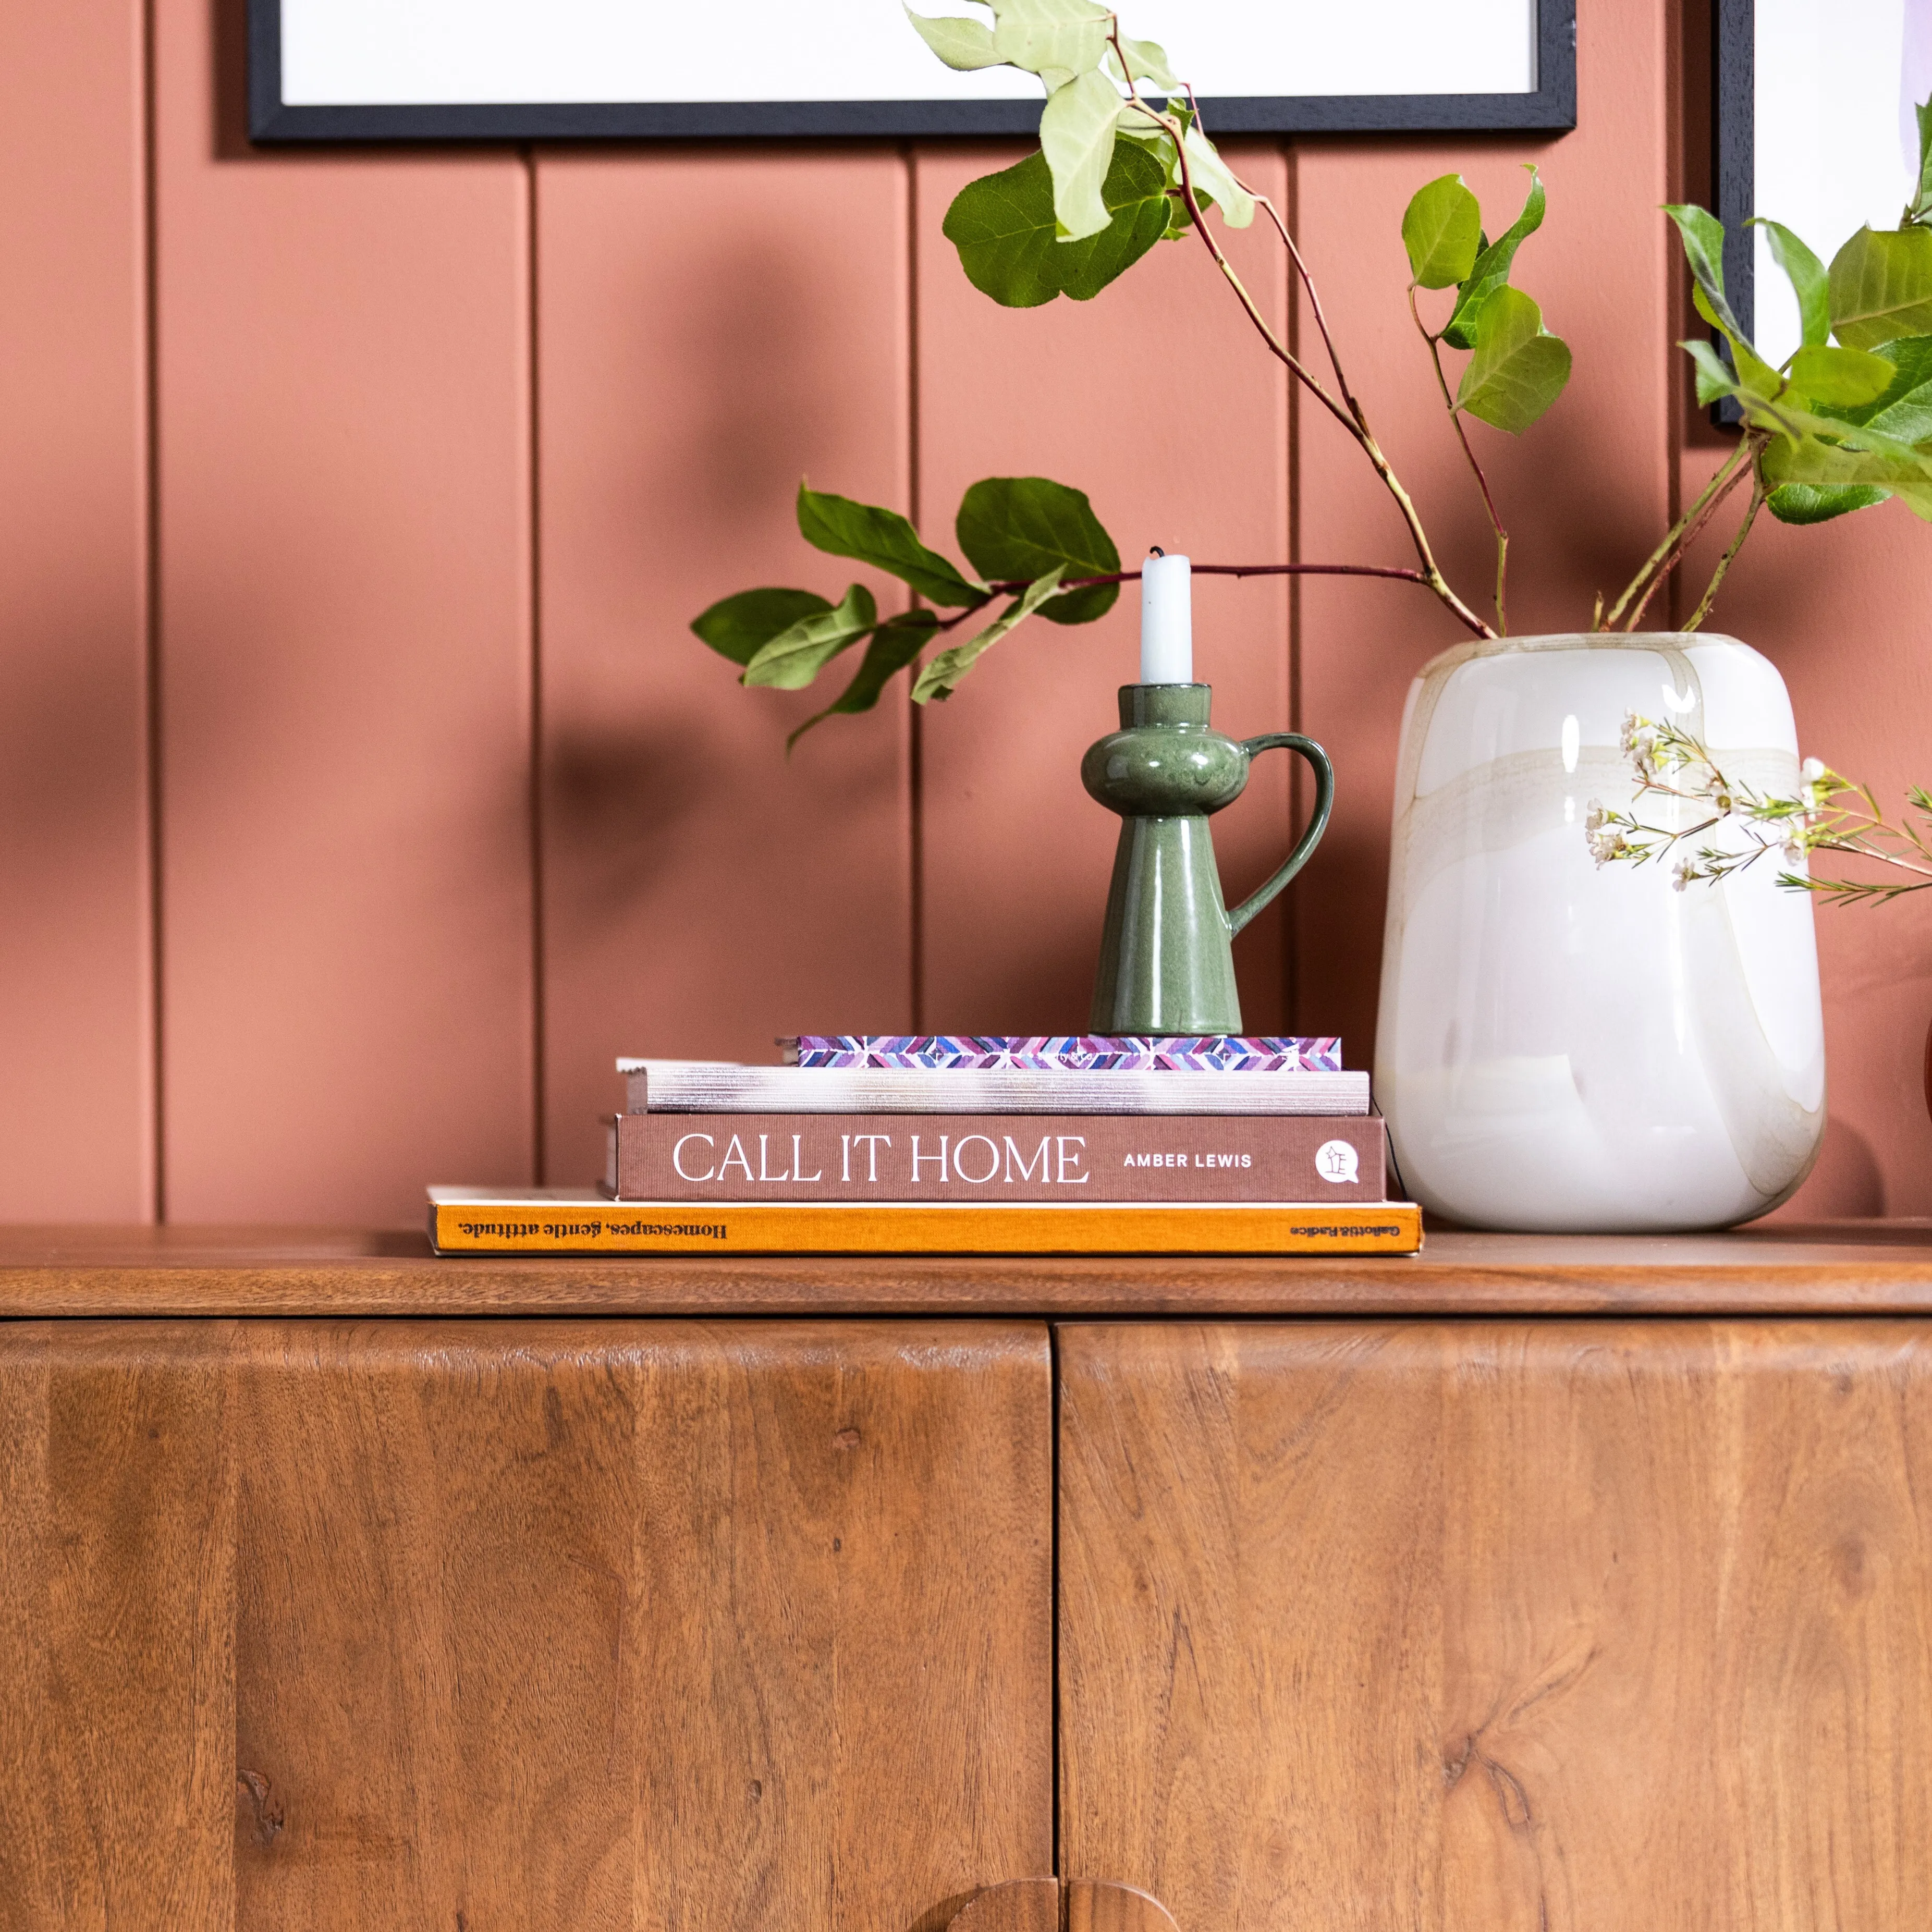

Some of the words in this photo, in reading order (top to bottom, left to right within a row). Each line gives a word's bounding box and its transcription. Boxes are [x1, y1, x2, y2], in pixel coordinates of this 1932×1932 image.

[672, 1133, 822, 1182] CALL
[841, 1134, 891, 1182] IT
[911, 1134, 1090, 1183] HOME
[1123, 1153, 1188, 1167] AMBER
[1195, 1154, 1252, 1168] LEWIS
[458, 1223, 540, 1239] attitude.
[544, 1221, 602, 1239] gentle
[606, 1221, 727, 1239] Homescapes,
